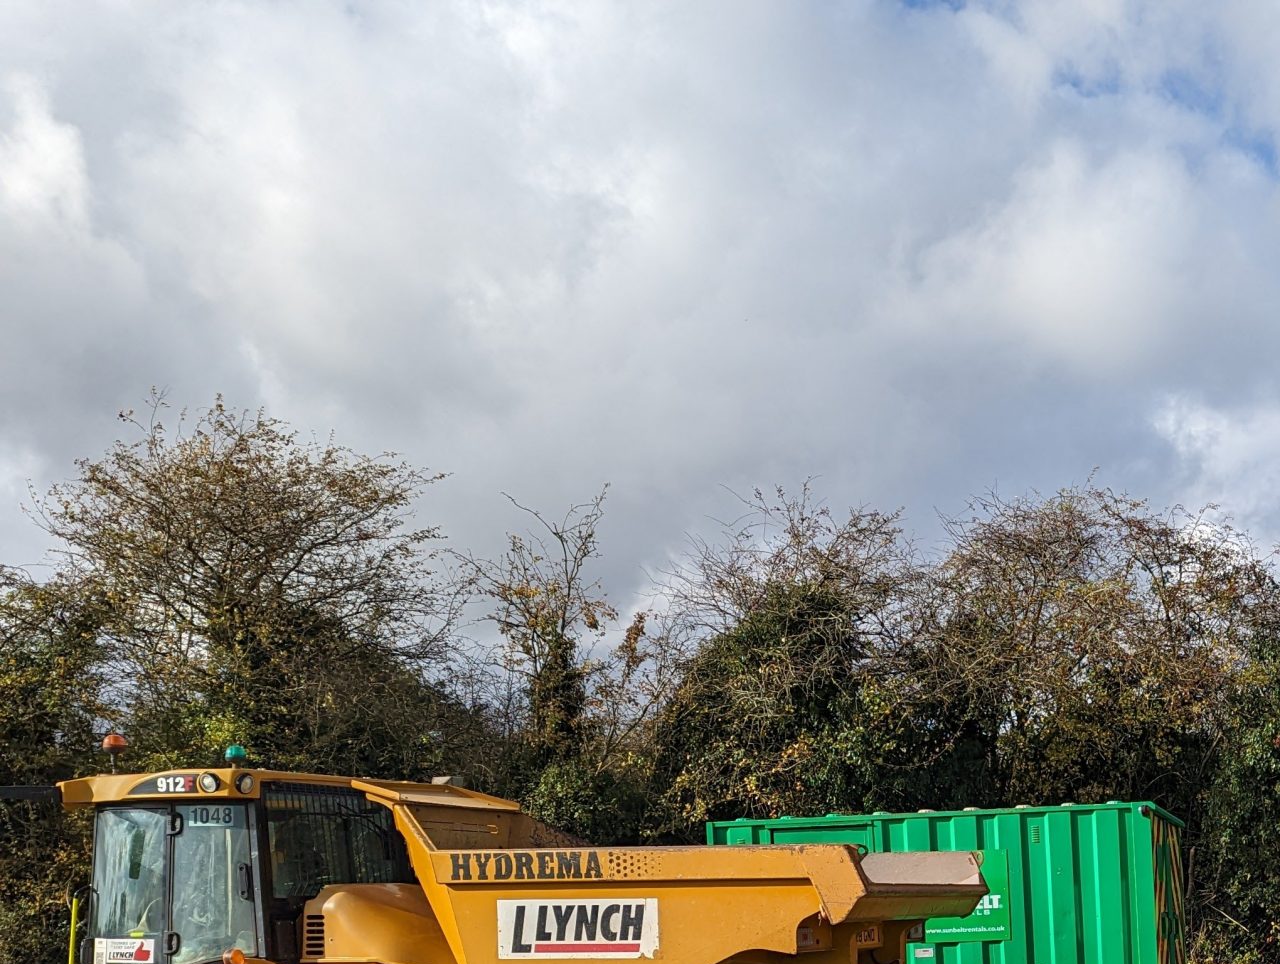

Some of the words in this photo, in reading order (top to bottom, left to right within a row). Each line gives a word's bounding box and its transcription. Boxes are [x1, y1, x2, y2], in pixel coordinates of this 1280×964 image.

[157, 776, 194, 792] 912F
[190, 807, 232, 824] 1048
[450, 851, 604, 881] HYDREMA
[925, 925, 1005, 934] www.sunbeltrentals.co.uk
